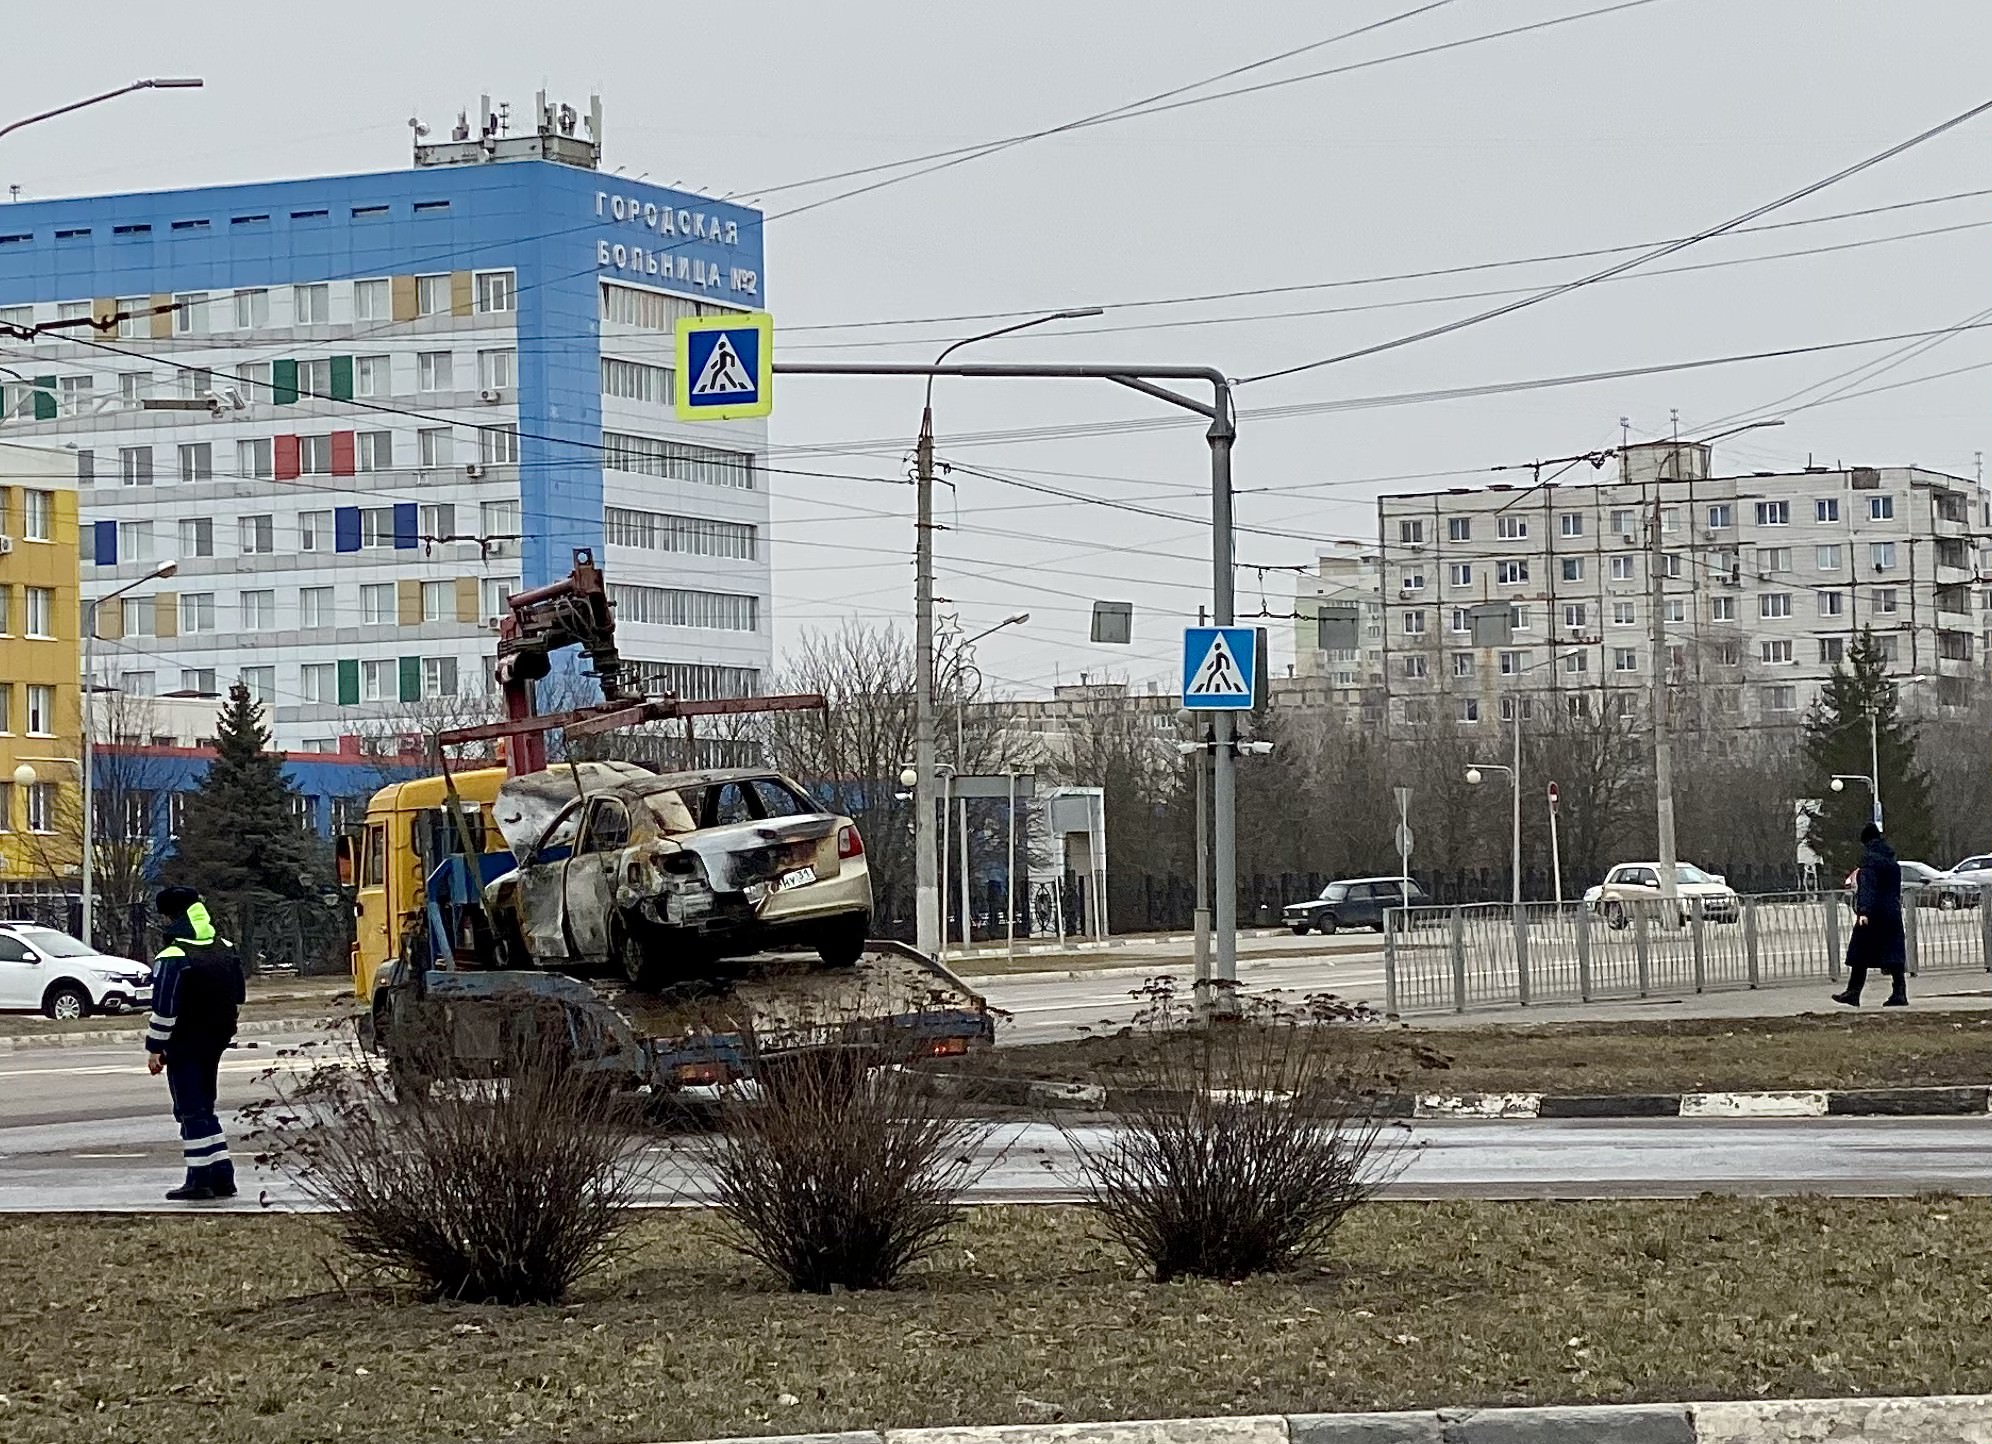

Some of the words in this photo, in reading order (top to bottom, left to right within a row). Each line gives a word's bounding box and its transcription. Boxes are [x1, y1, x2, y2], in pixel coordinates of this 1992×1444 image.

[595, 191, 738, 245] ГОРОДСКАЯ
[597, 240, 721, 290] БОЛЬНИЦА
[730, 267, 758, 295] №2
